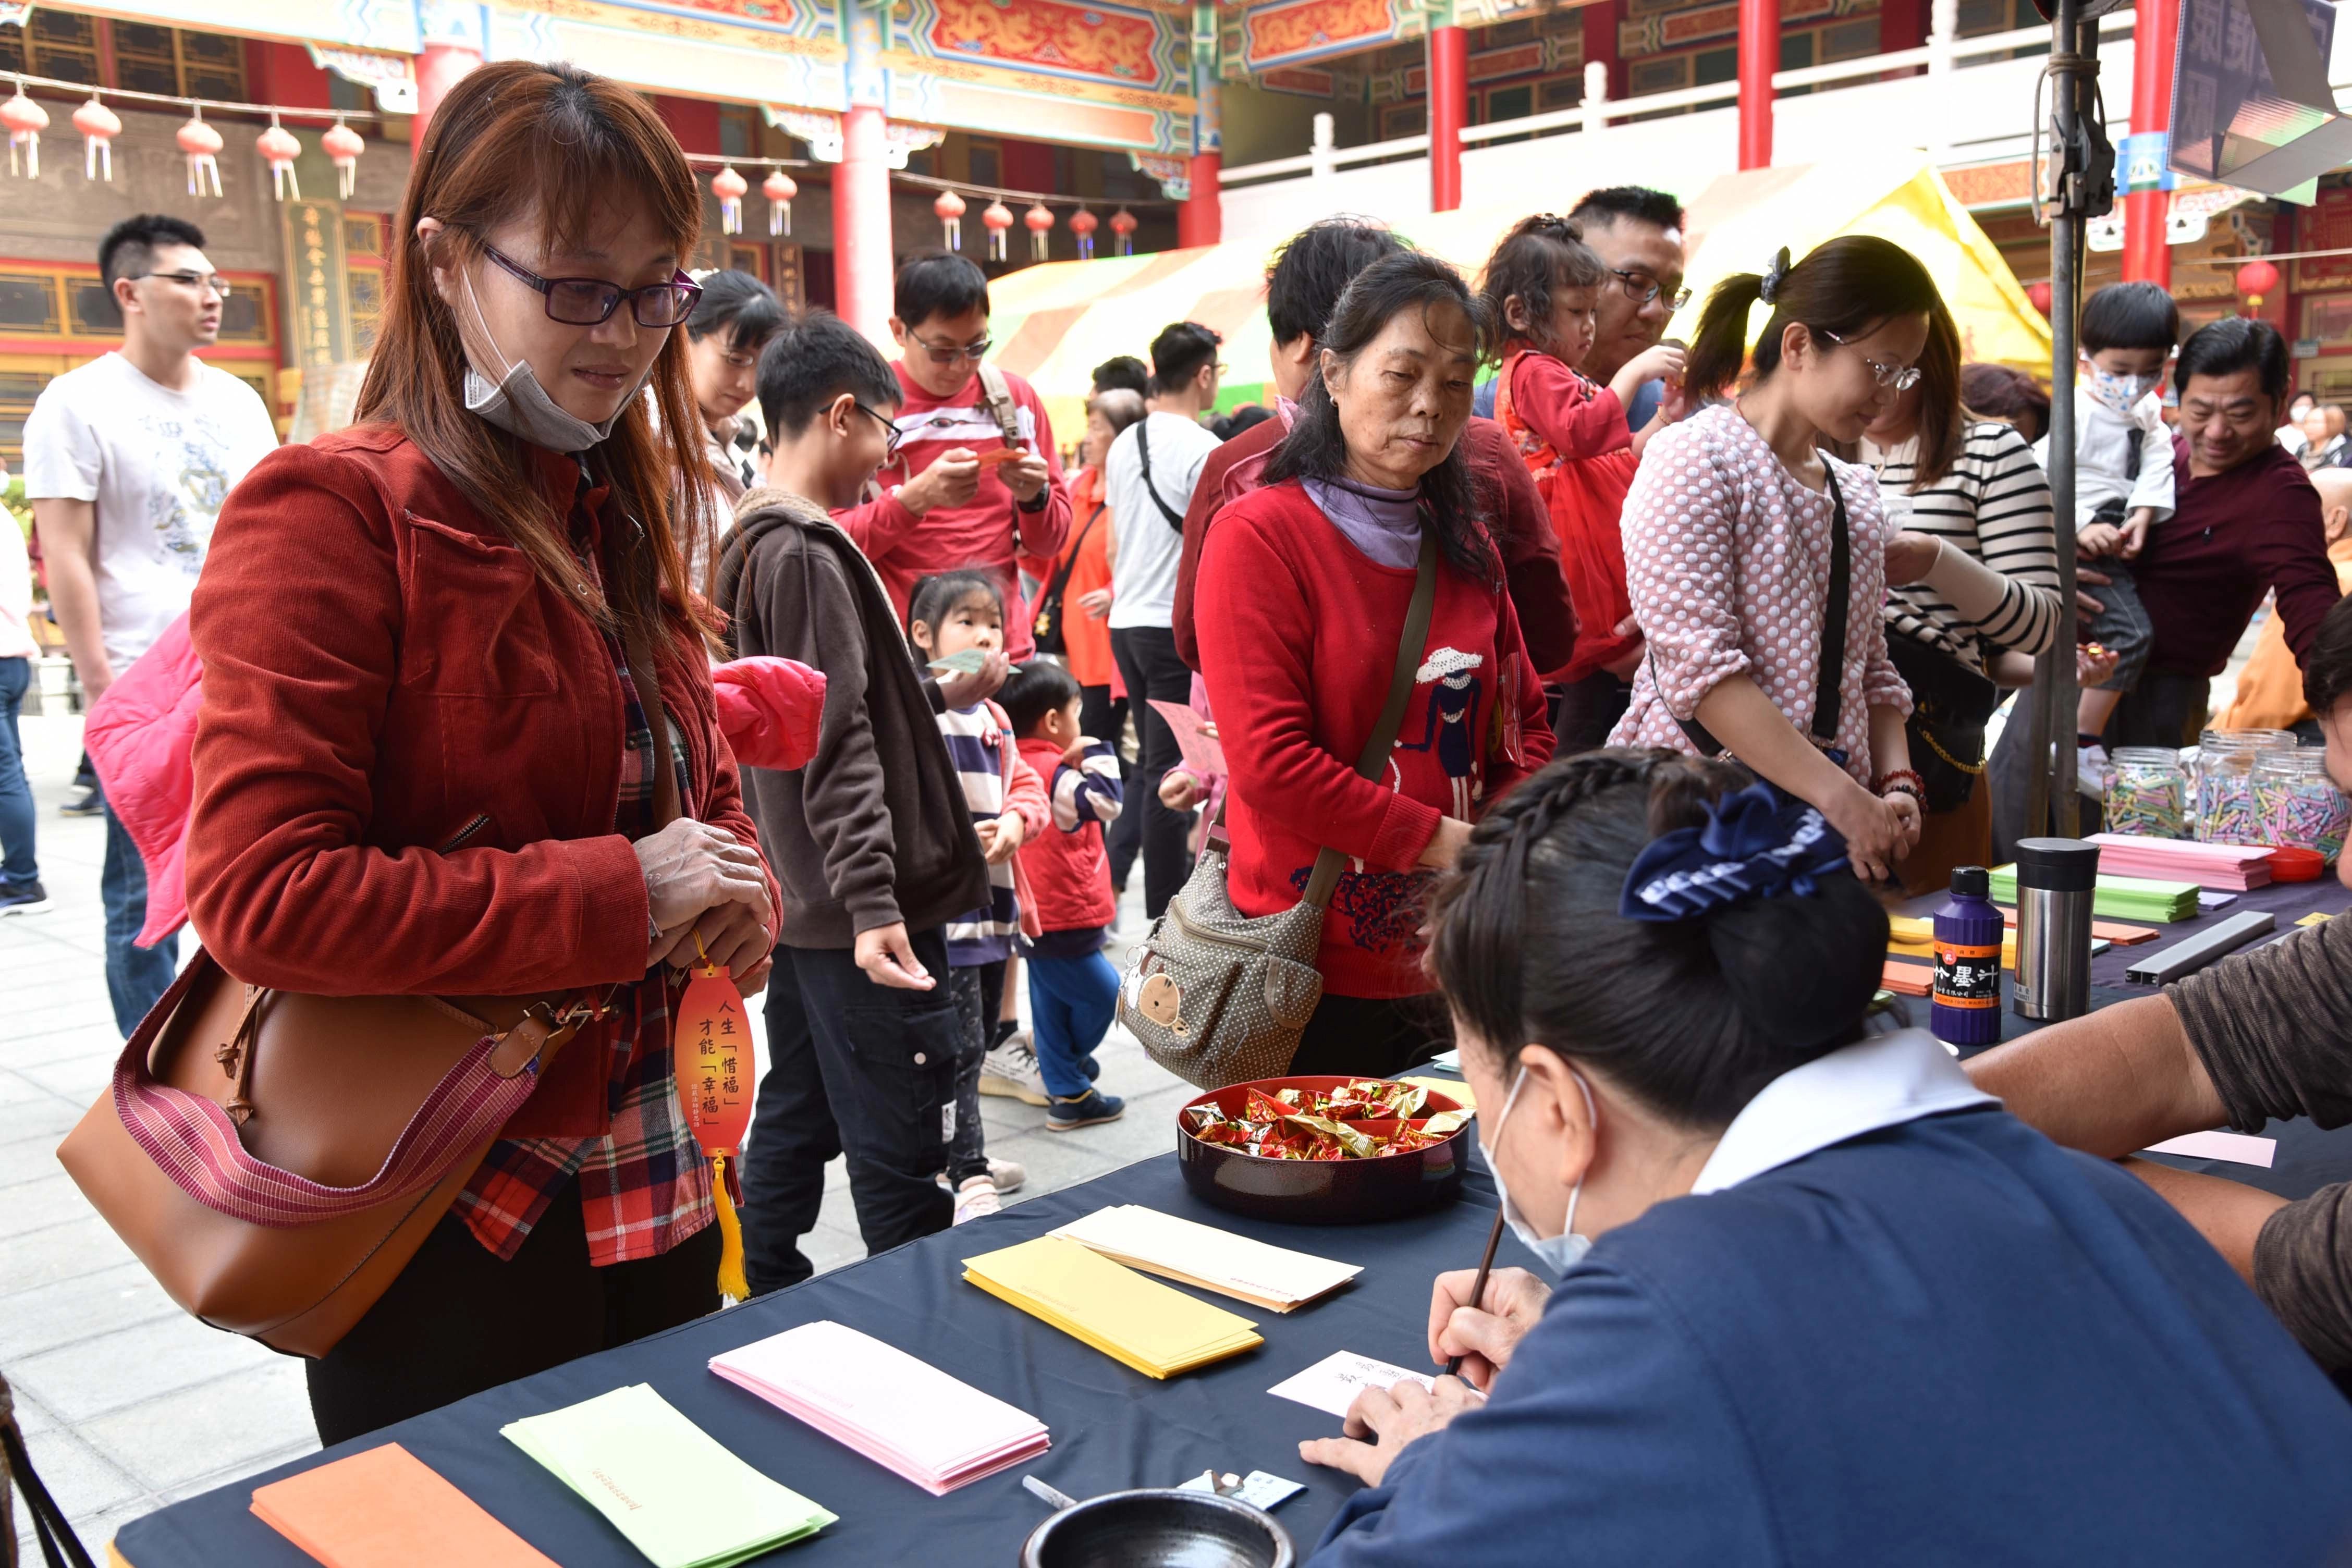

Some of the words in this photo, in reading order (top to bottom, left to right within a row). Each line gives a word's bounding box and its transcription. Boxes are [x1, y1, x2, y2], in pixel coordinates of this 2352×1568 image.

[1934, 985, 1969, 998] 企業有限公司
[698, 1018, 720, 1125] 才能「幸福」
[718, 1000, 740, 1106] 人生「惜福」
